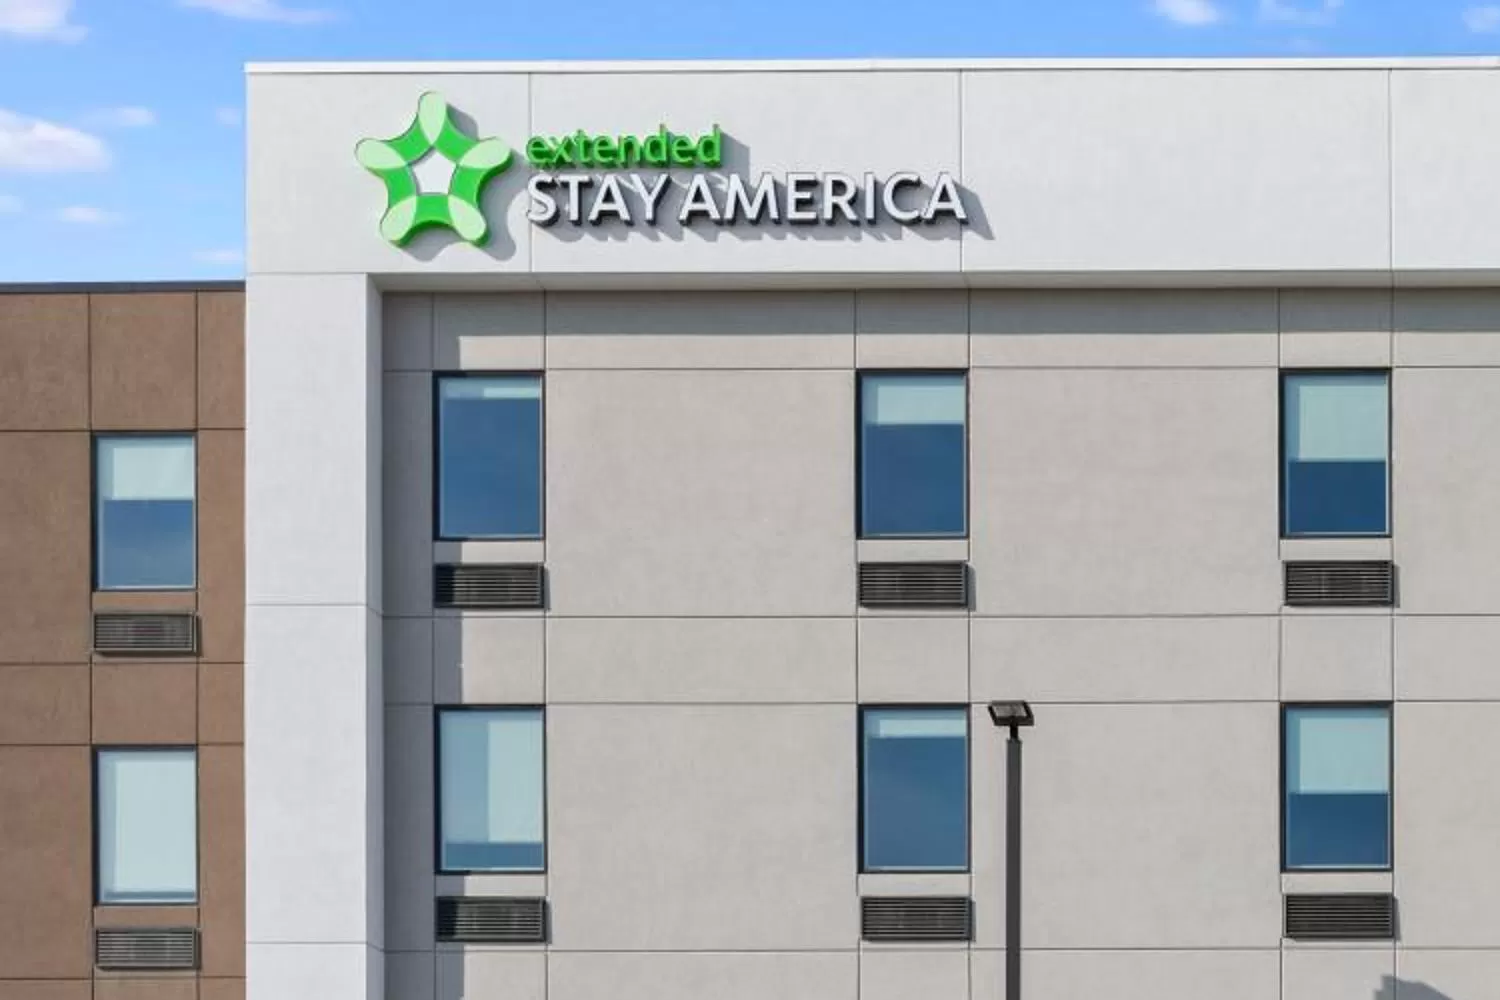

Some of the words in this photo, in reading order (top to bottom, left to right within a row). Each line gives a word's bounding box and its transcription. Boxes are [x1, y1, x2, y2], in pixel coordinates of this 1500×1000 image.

[526, 124, 721, 167] extended
[527, 172, 672, 226] STAY
[679, 171, 968, 225] AMERICA
